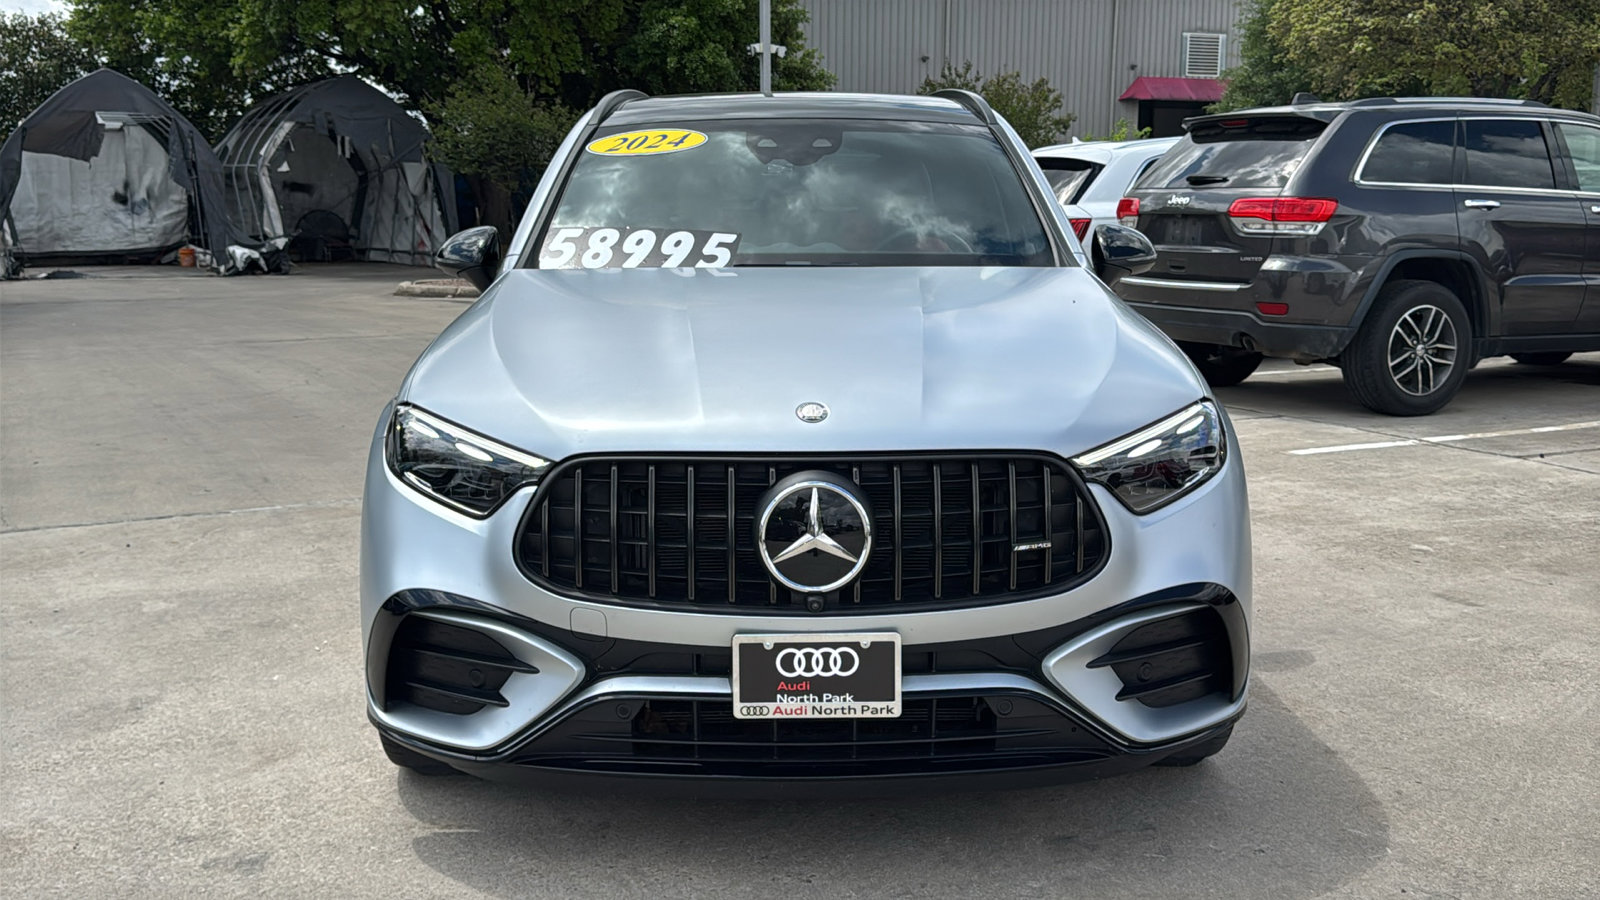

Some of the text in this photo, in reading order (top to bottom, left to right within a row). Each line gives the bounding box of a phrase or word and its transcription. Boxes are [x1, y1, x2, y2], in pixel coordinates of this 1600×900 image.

[605, 132, 692, 152] 2024
[1167, 194, 1190, 205] Jeep
[539, 228, 738, 269] 58995
[777, 681, 811, 691] Audi
[776, 692, 855, 703] North Park
[772, 704, 895, 716] Audi North Park
